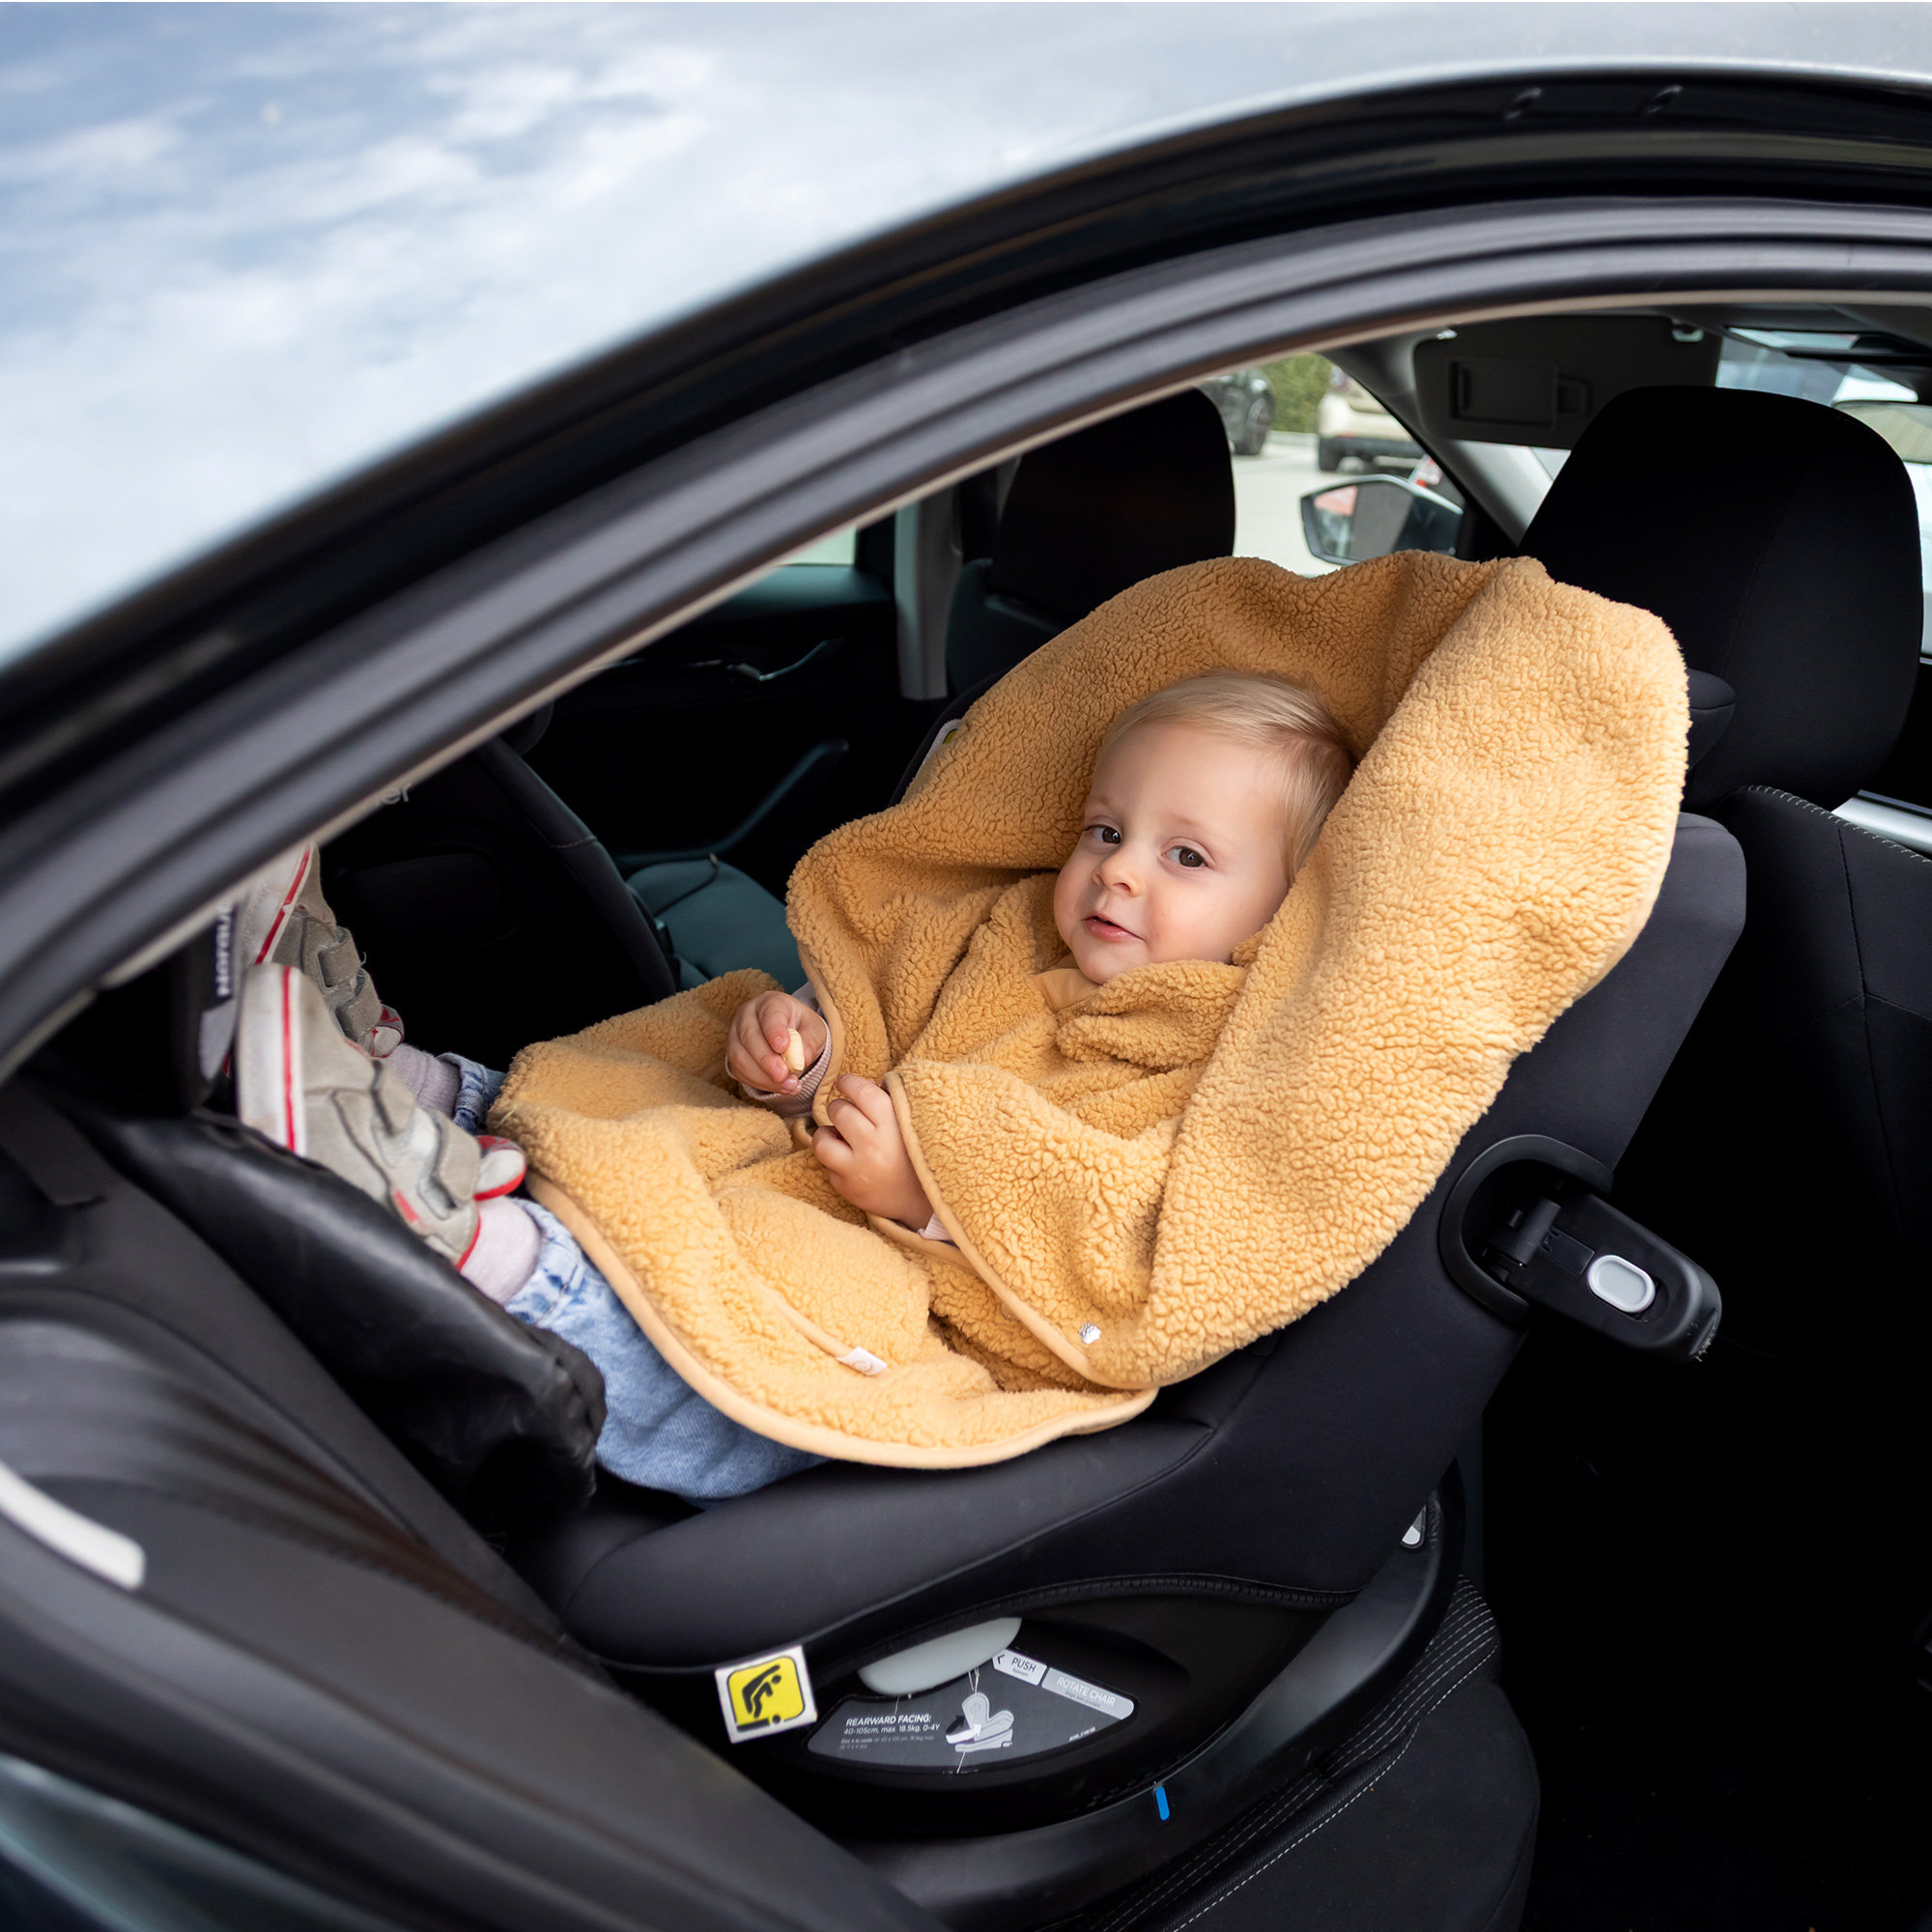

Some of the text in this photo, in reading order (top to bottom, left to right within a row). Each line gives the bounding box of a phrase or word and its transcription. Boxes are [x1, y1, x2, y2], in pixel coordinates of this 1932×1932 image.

[1010, 1657, 1037, 1672] PUSH
[1056, 1677, 1090, 1696] ROTATE
[1090, 1688, 1117, 1707] CHAIR
[845, 1714, 932, 1727] REARWARD FACING:
